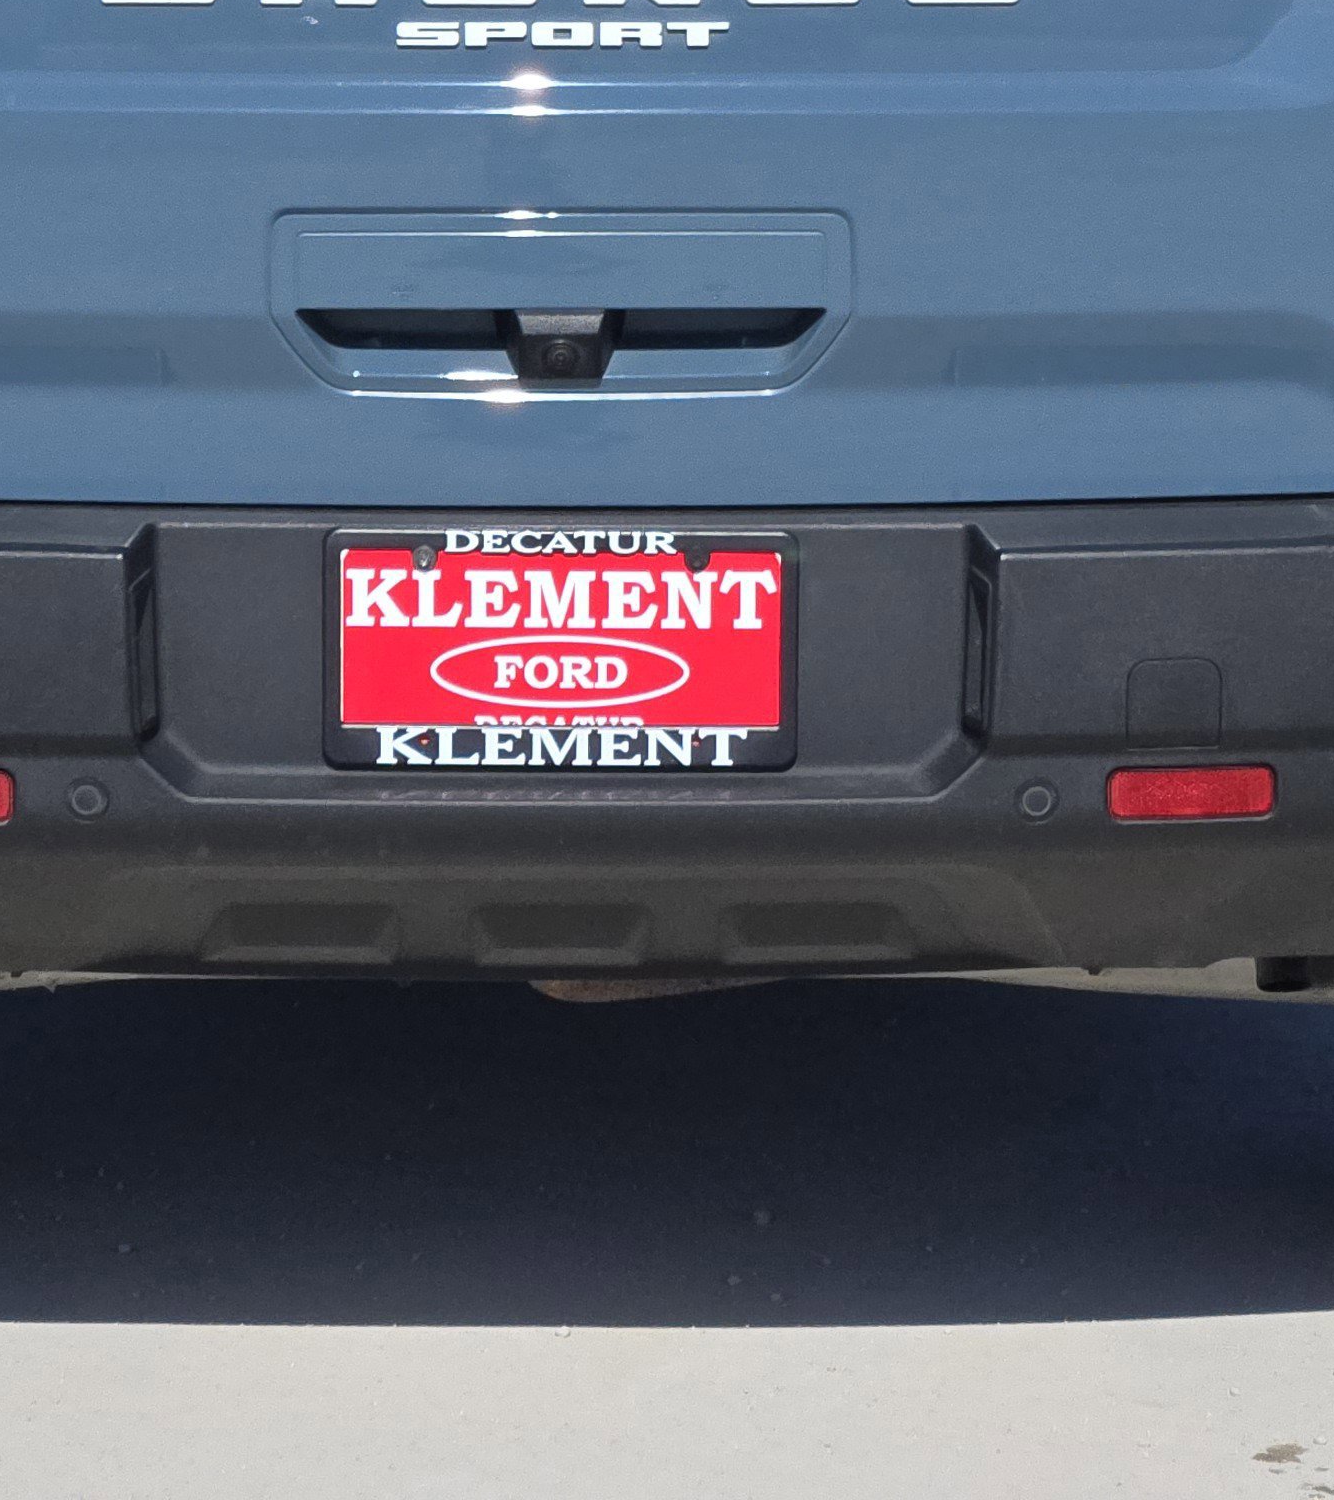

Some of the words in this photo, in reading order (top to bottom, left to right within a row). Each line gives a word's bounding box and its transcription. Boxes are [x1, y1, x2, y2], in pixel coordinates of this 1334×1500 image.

[396, 21, 730, 47] SPORT
[444, 529, 678, 555] DECATUR
[345, 568, 778, 630] KLEMENT
[494, 655, 628, 690] FORD
[375, 726, 748, 767] KLEMENT
